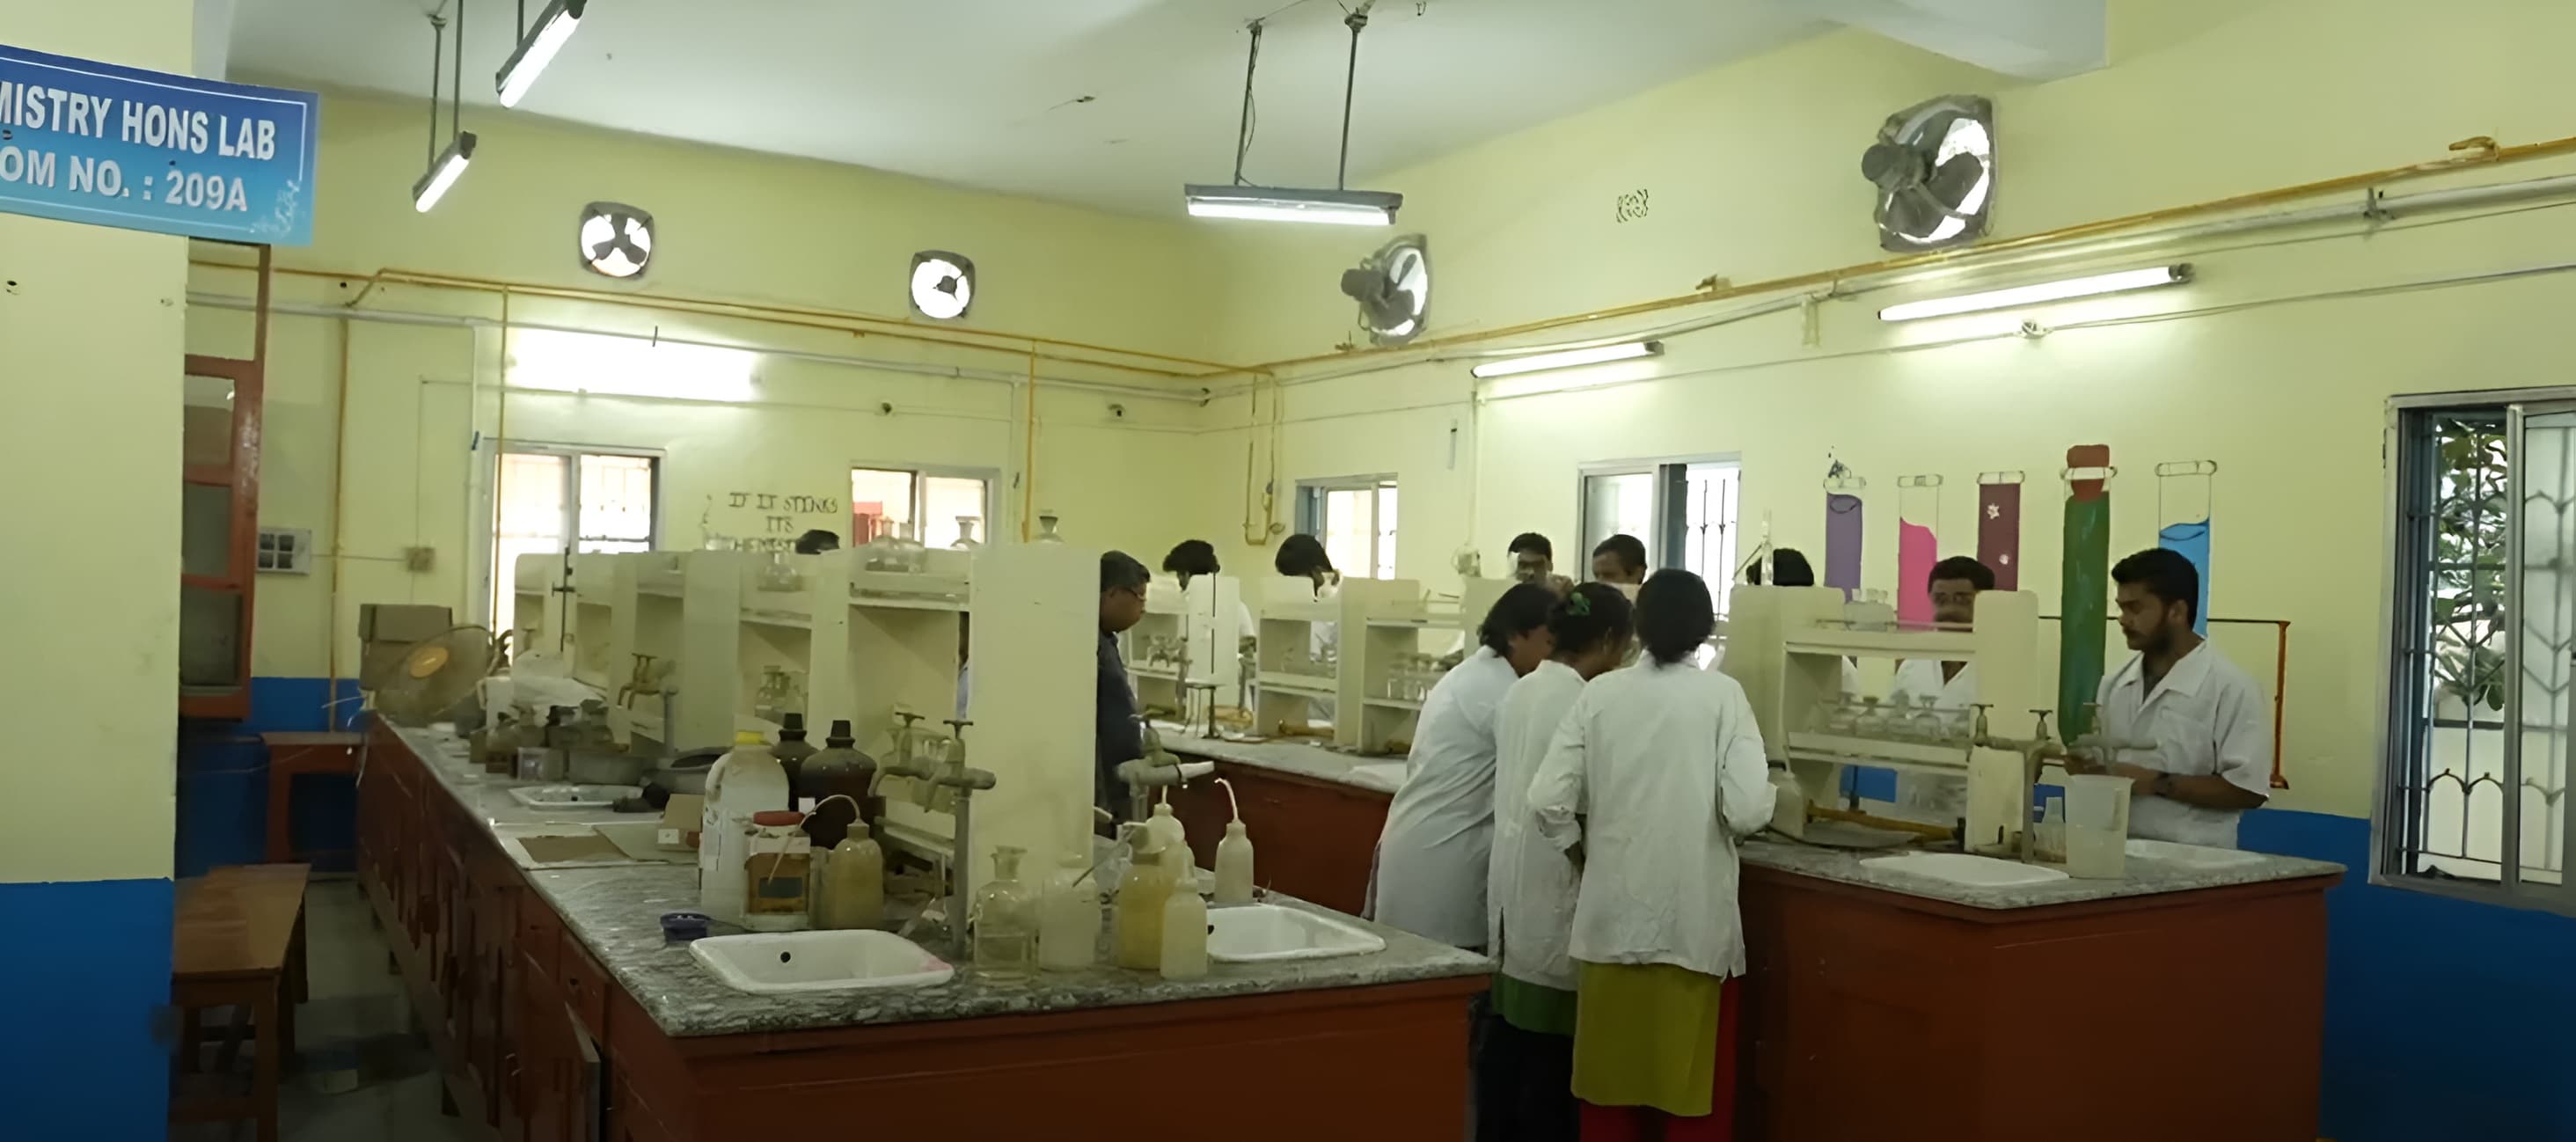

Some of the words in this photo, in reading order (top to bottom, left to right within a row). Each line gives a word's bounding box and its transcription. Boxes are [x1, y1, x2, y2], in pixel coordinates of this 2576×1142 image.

[122, 100, 209, 154] HONS
[218, 114, 275, 160] LAB
[0, 145, 55, 187] OM
[70, 155, 129, 198] NO.
[165, 169, 247, 211] 209A
[728, 492, 750, 508] IF
[757, 494, 778, 509] IT
[783, 495, 838, 514] STINKS
[765, 516, 794, 533] ITS
